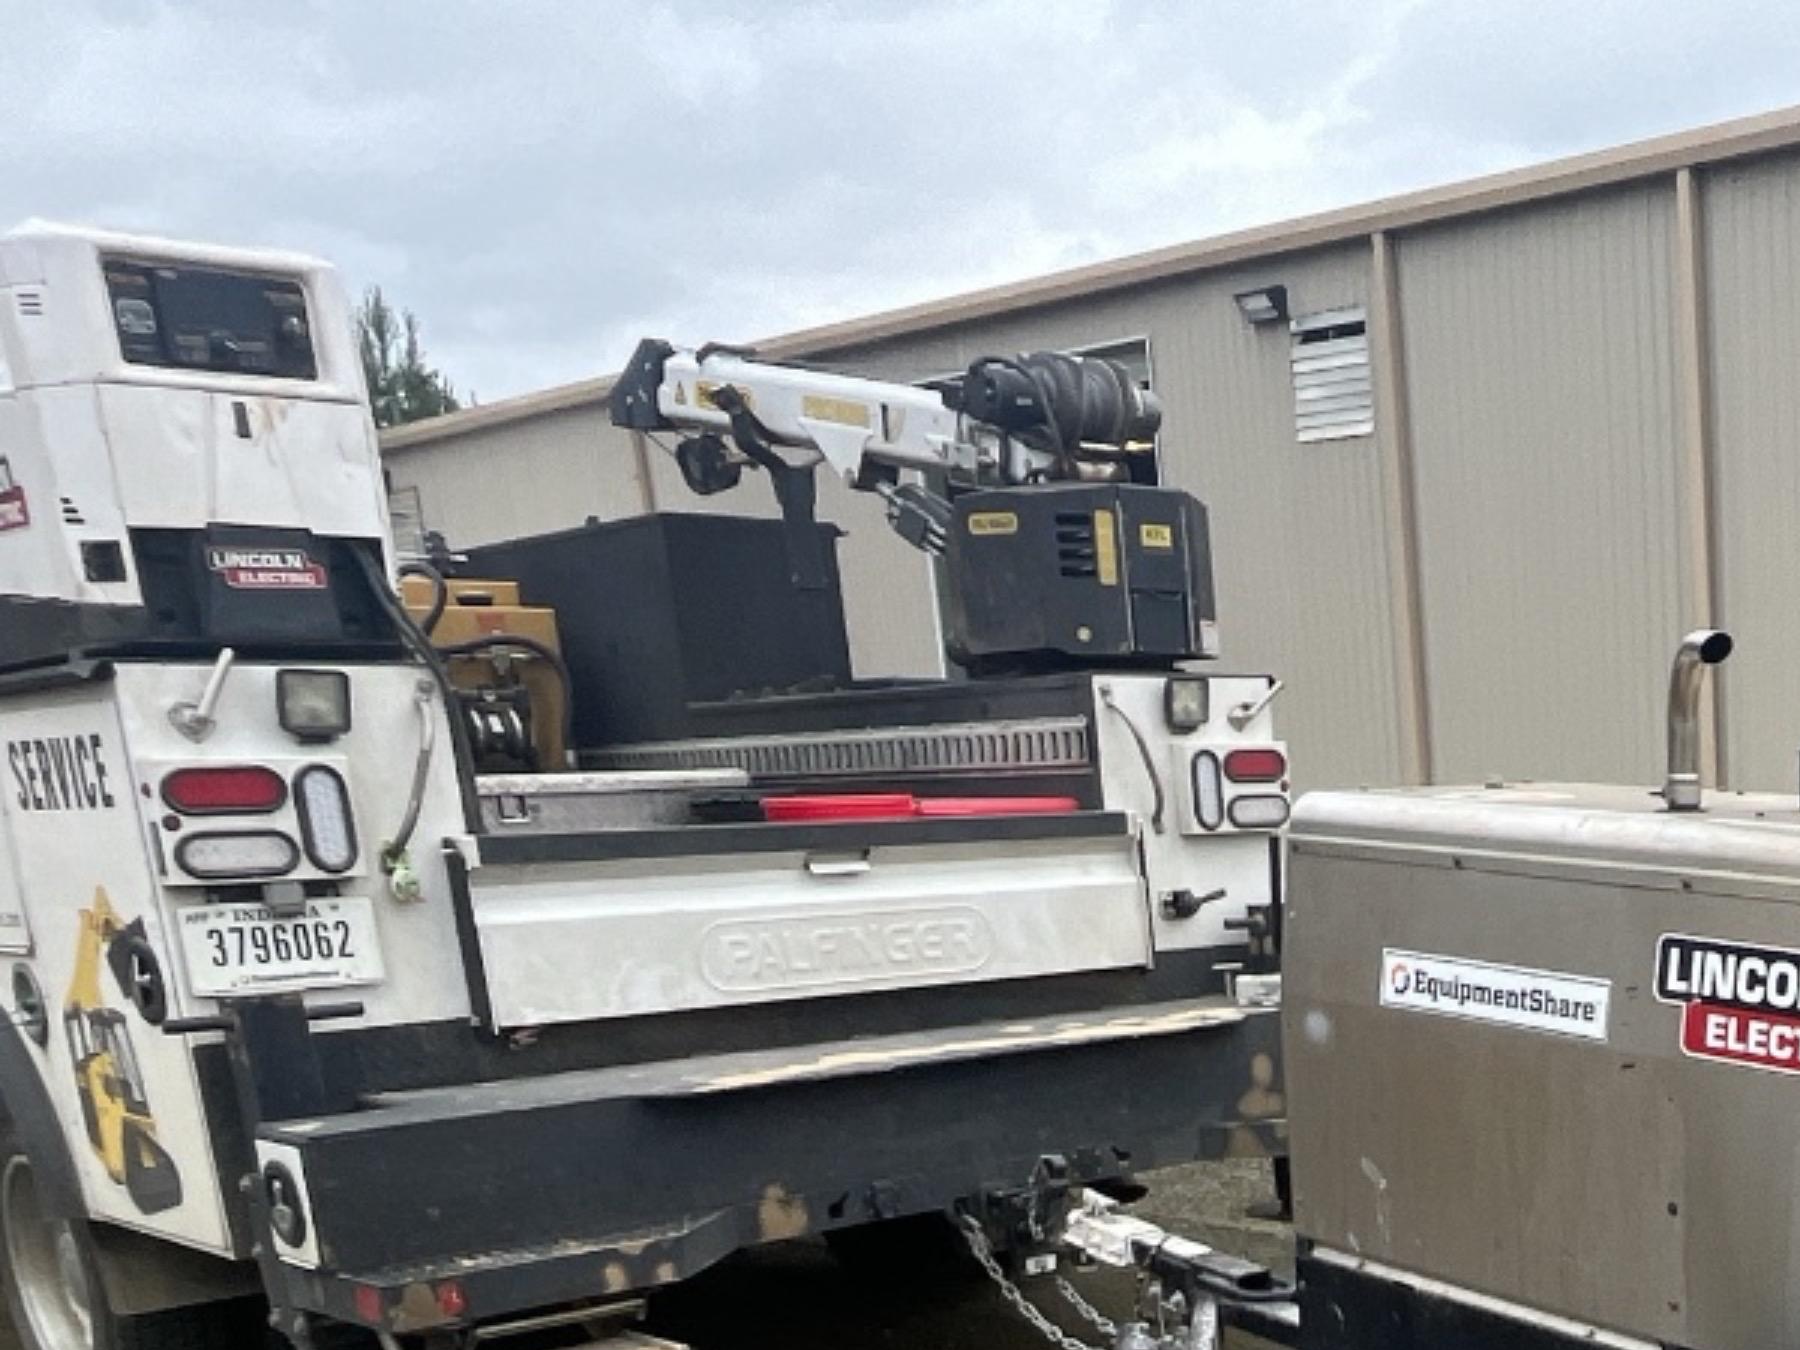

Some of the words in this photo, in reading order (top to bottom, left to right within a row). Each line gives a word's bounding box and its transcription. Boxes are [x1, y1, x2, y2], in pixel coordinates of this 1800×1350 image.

[211, 550, 304, 569] LINCOLN
[8, 734, 114, 810] SERVICE
[232, 905, 321, 922] INDA
[206, 920, 355, 967] 3796062
[719, 920, 975, 981] PALFINGER
[1413, 968, 1596, 1022] EquipmentShare
